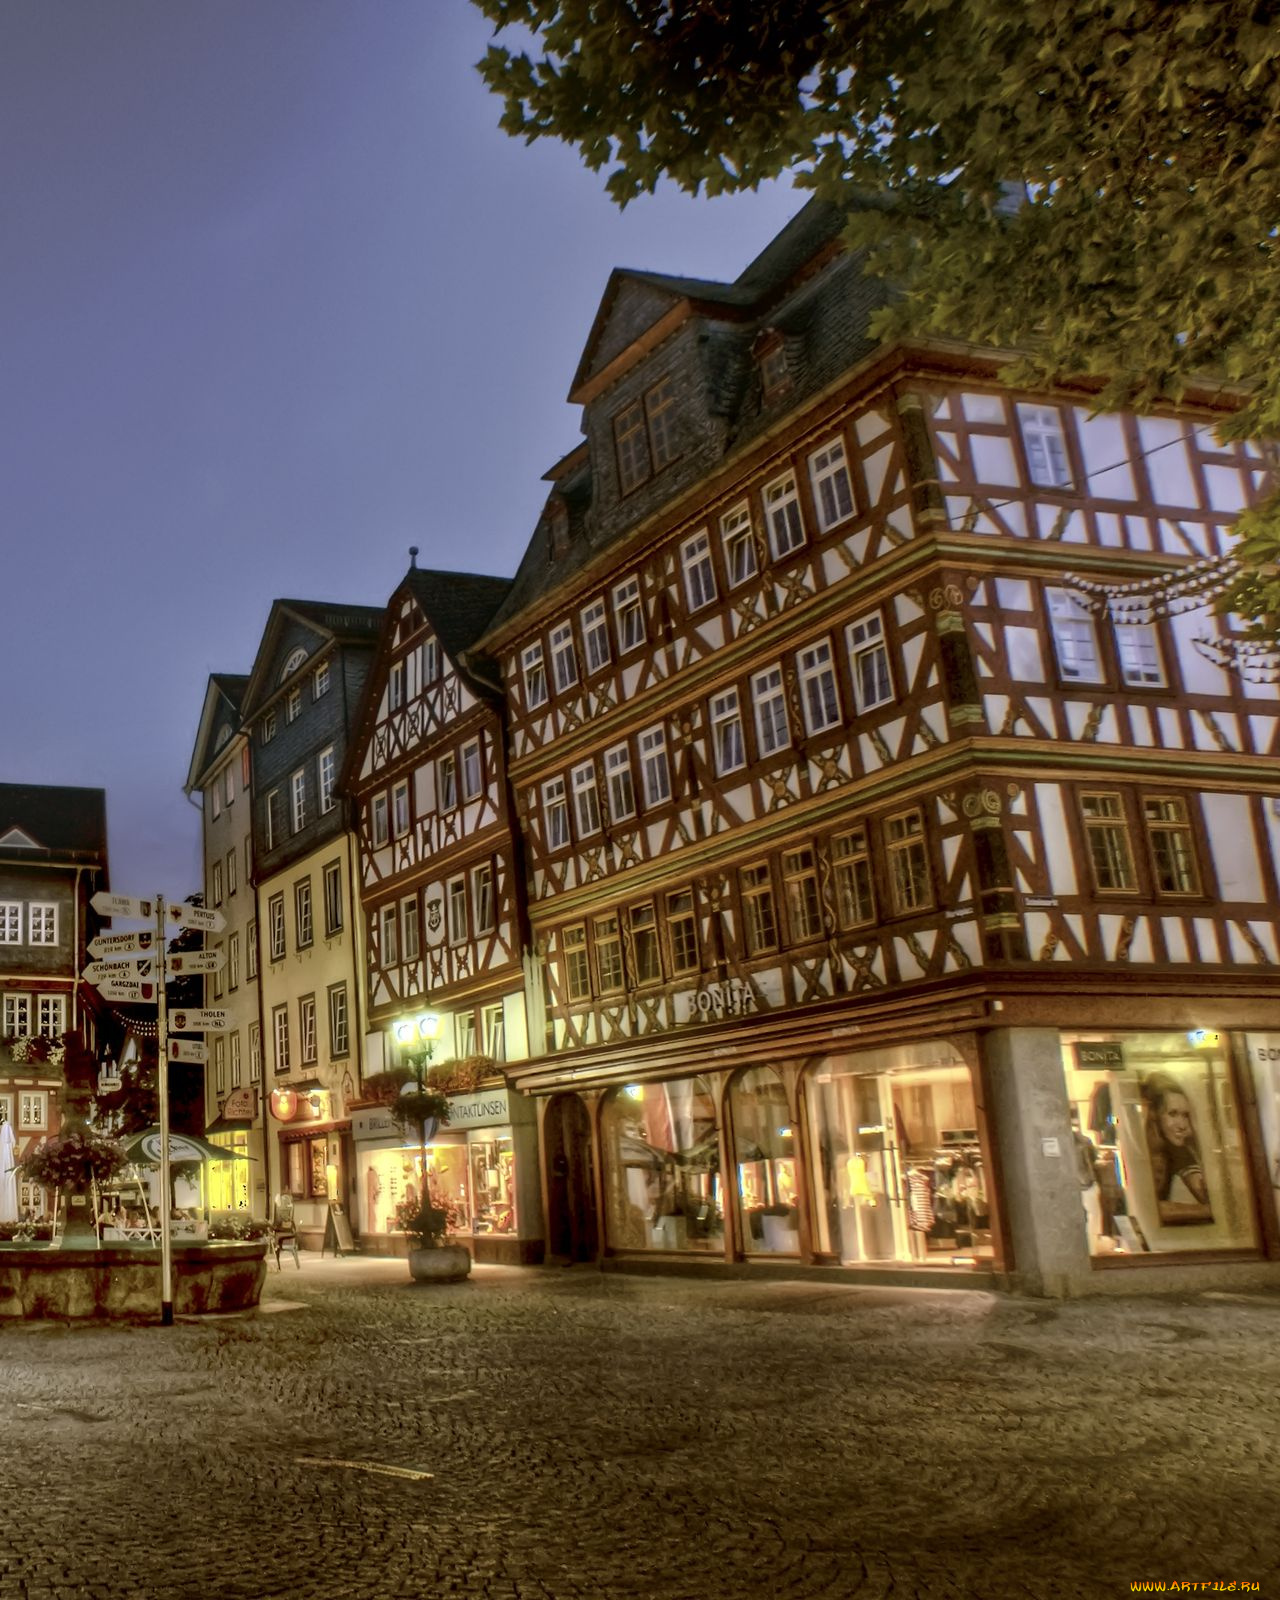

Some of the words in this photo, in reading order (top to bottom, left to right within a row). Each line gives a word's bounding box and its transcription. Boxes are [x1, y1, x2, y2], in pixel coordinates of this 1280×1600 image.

[193, 910, 215, 920] PERTUIS
[94, 934, 134, 946] GUNTERSDORF
[92, 961, 130, 972] SCHÖNBACH
[688, 980, 756, 1015] BONITA
[1258, 1048, 1280, 1061] BO
